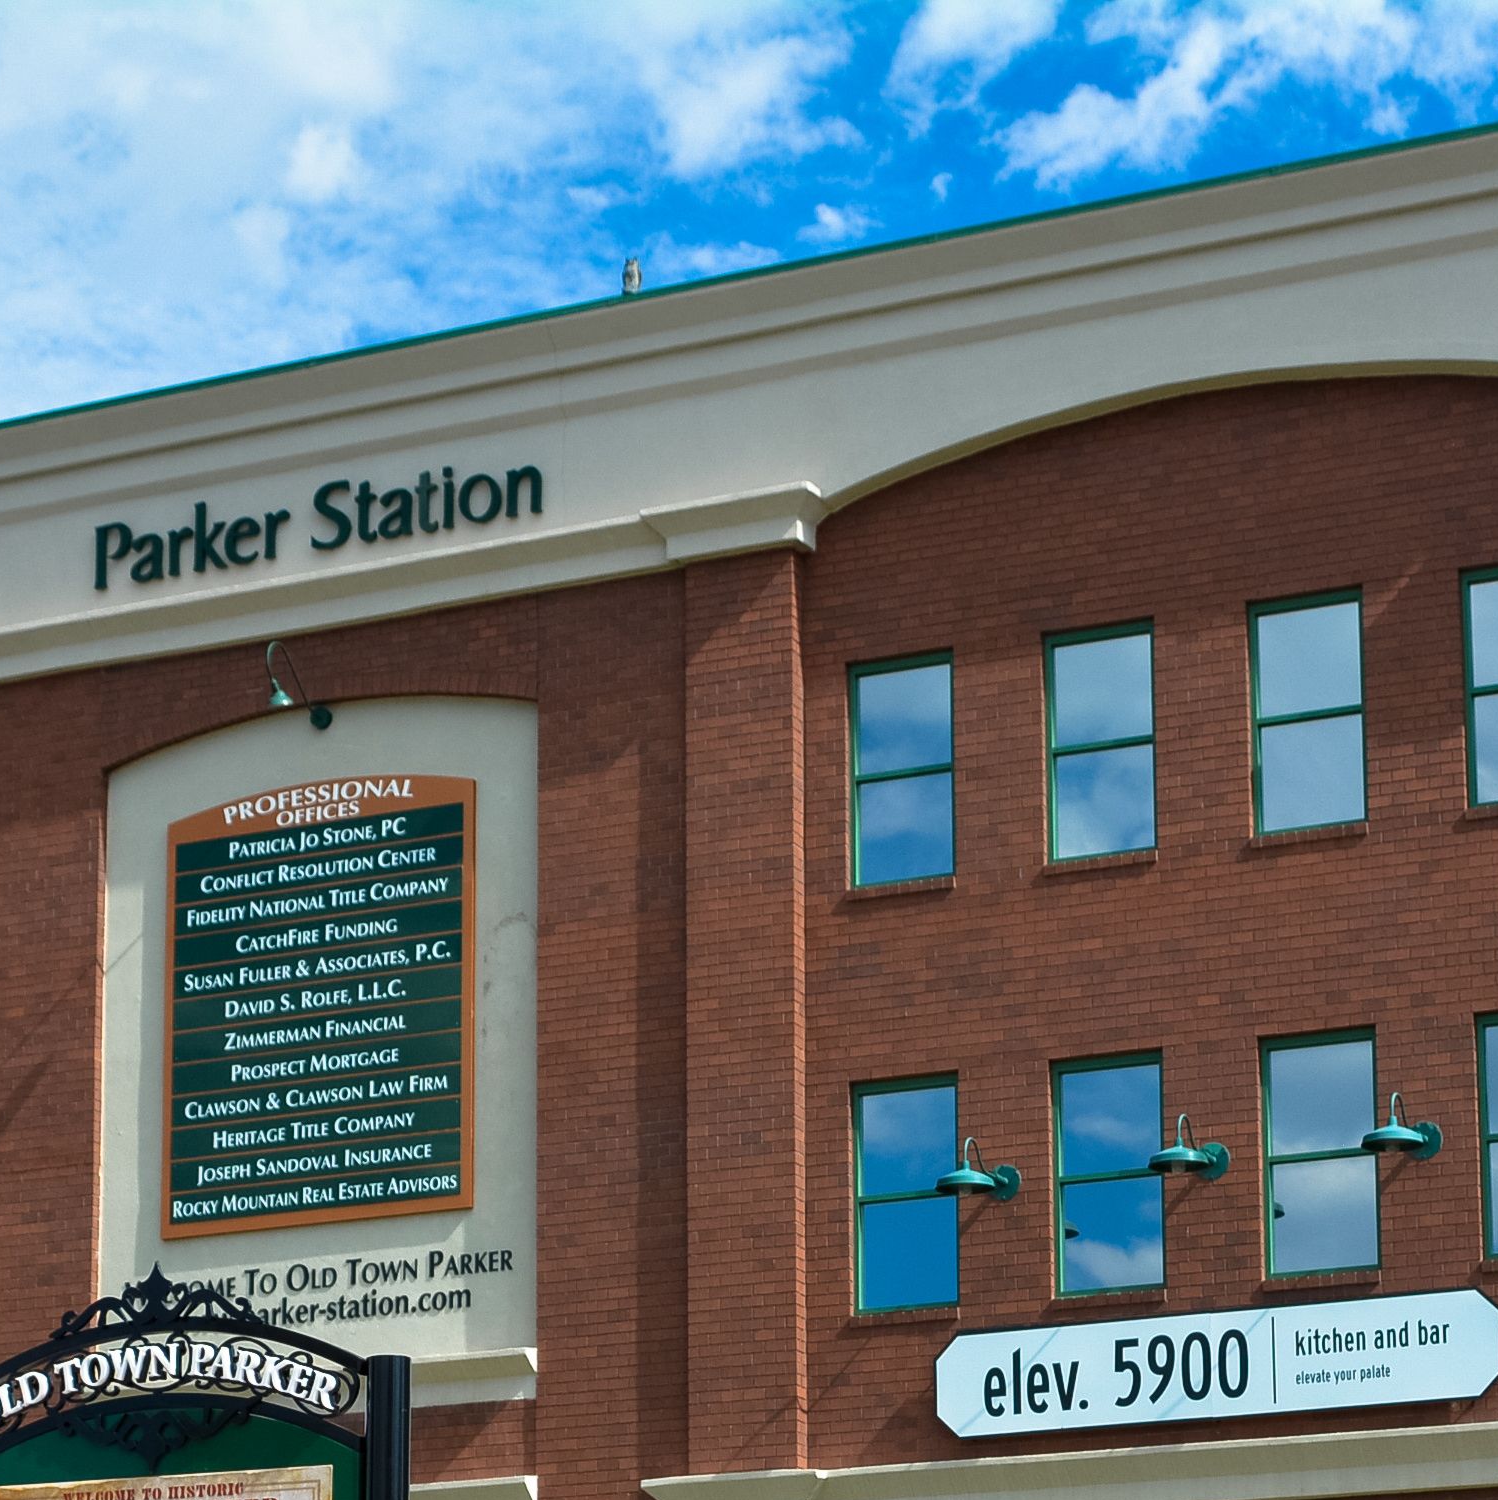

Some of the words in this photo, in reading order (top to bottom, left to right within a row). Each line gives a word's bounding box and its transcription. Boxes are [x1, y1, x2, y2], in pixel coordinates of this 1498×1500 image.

[94, 500, 291, 591] Parker
[310, 465, 543, 551] Station
[223, 779, 413, 825] PROFESSIONAL
[276, 800, 360, 828] OFFICES
[228, 836, 295, 860] PATRICIA
[300, 831, 319, 853] JO
[323, 824, 377, 847] STONE,
[381, 817, 407, 838] PC
[200, 870, 274, 895] CONFLICT
[278, 856, 374, 883] RESOLUTION
[377, 847, 436, 867] CENTER
[186, 906, 246, 927] FIDELITY
[249, 894, 325, 918] NATIONAL
[328, 887, 366, 908] TITLE
[370, 877, 449, 901] COMPANY
[235, 929, 319, 953] CATCHFIRE
[325, 919, 398, 942] FUNDING
[184, 971, 234, 993] SUSAN
[239, 962, 291, 985] FULLER
[296, 960, 310, 978] &
[315, 949, 410, 976] ASSOCIATES,
[415, 941, 451, 962] P.C.
[224, 996, 276, 1019] DAVID
[280, 993, 295, 1012] S.
[300, 986, 352, 1008] ROLFE,
[357, 979, 406, 1001] L.L.C.
[224, 1024, 321, 1051] ZIMMERMAN
[325, 1014, 406, 1038] FINANCIAL
[230, 1059, 305, 1082] PROSPECT
[309, 1048, 400, 1073] MORTGAGE
[184, 1096, 261, 1119] CLAWSON
[266, 1092, 280, 1109] &
[285, 1085, 363, 1107] CLAWSON
[368, 1078, 403, 1097] LAW
[409, 1074, 448, 1092] FIRM
[212, 1127, 286, 1149] HERITAGE
[290, 1119, 329, 1140] TITLE
[334, 1112, 415, 1135] COMPANY
[197, 1163, 251, 1186] JOSEPH
[256, 1152, 339, 1177] SANDOVAL
[344, 1143, 432, 1167] INSURANCE
[172, 1198, 218, 1218] ROCKY
[222, 1190, 298, 1214] MOUNTAIN
[302, 1185, 335, 1204] REAL
[338, 1181, 384, 1200] ESTATE
[387, 1174, 458, 1197] ADVISORS
[244, 1268, 277, 1296] TO
[286, 1264, 337, 1292] OLD
[346, 1258, 418, 1286] TOWN
[428, 1249, 513, 1279] PARKER
[1294, 1321, 1367, 1357] kitchen
[1373, 1319, 1410, 1349] and
[1416, 1318, 1450, 1346] bar
[54, 1343, 188, 1395] TOWN
[188, 1342, 338, 1411] PARKER
[983, 1348, 1089, 1418] elev.
[1113, 1328, 1250, 1408] 5900
[1295, 1368, 1332, 1386] elevate
[1333, 1369, 1357, 1385] your
[1359, 1364, 1391, 1382] palate
[141, 1486, 162, 1500] TO
[168, 1482, 244, 1499] HISTORIC
